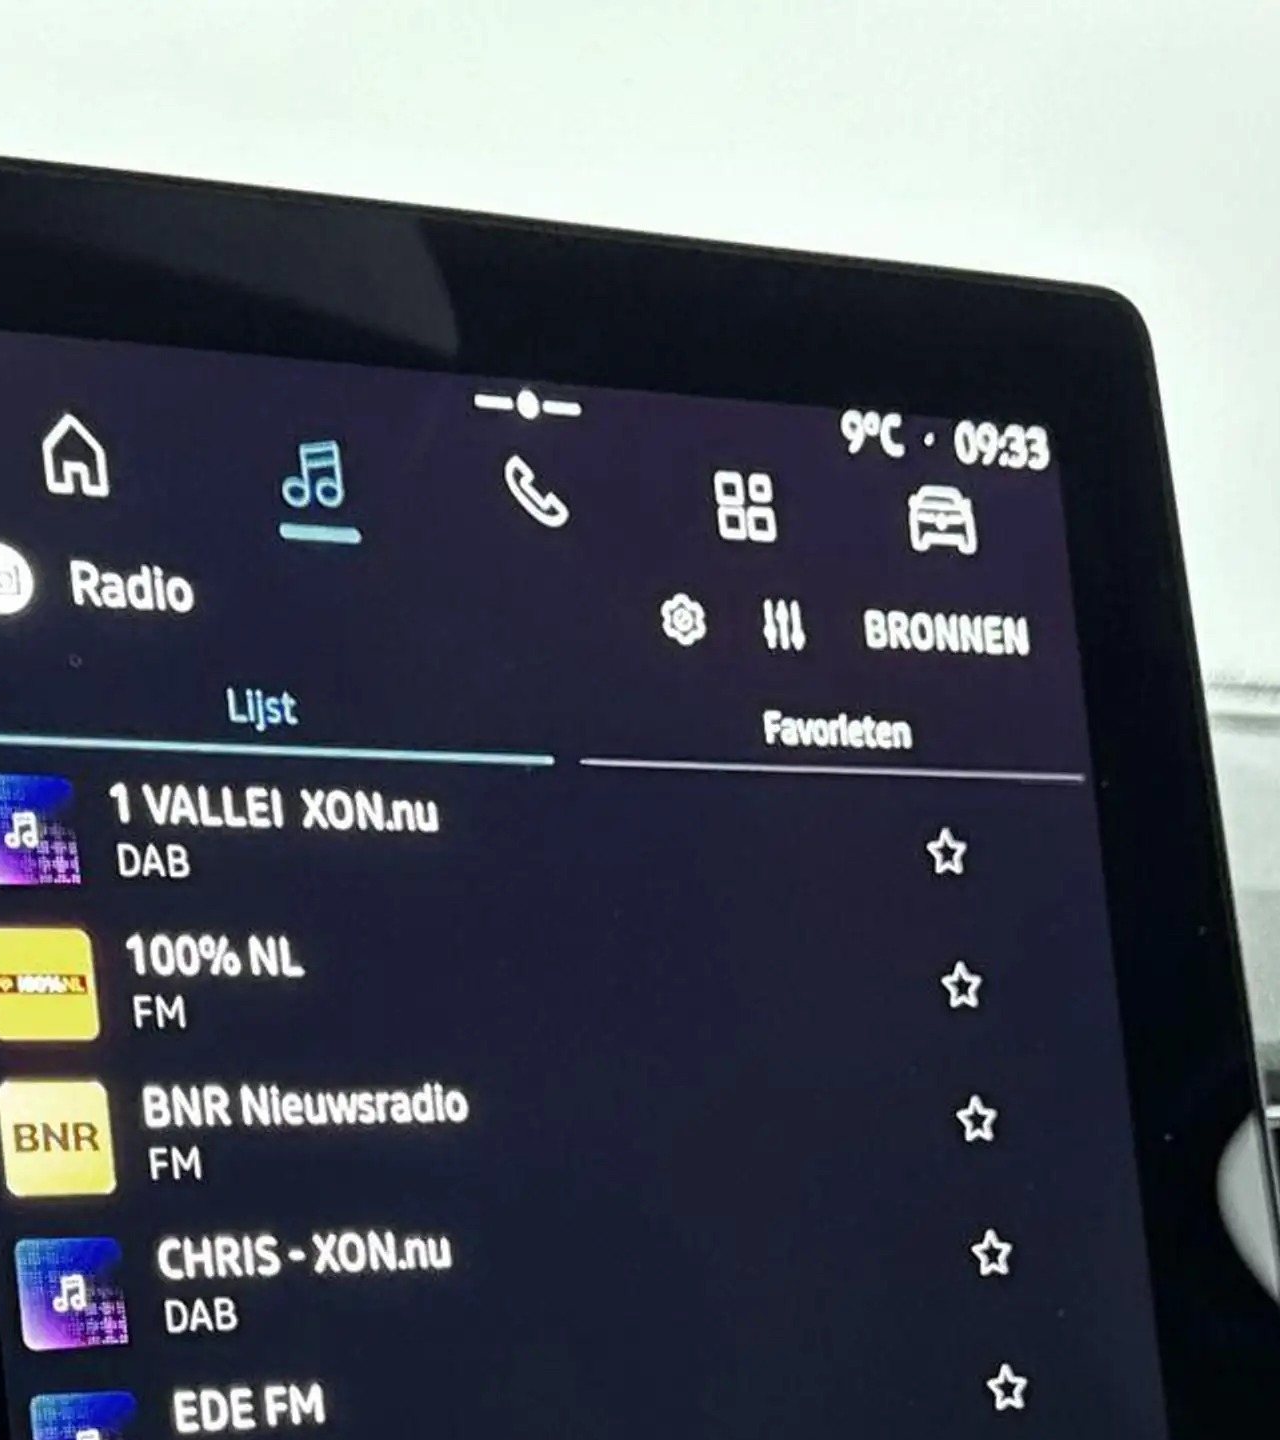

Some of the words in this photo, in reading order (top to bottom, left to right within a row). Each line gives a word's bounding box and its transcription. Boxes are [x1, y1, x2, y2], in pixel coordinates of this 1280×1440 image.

[953, 419, 1050, 471] 09:33
[69, 559, 195, 613] Radio
[863, 609, 1030, 656] BRONNEN
[226, 687, 299, 732] Lijst
[762, 709, 913, 750] Favorieten
[109, 782, 131, 824] 1
[141, 783, 284, 829] VALLEI
[300, 788, 440, 833] XON.nu
[116, 843, 191, 878] DAB
[125, 933, 242, 977] 100%
[248, 934, 306, 978] NL
[133, 994, 187, 1029] FM
[142, 1084, 233, 1129] BNR
[239, 1082, 469, 1127] Nieuwsradio
[12, 1122, 102, 1154] BNR
[148, 1145, 202, 1181] FM
[157, 1234, 282, 1281] CHRIS
[311, 1229, 452, 1274] XON.nu
[164, 1296, 238, 1334] DAB
[173, 1387, 257, 1434] EDE
[263, 1382, 326, 1427] FM
